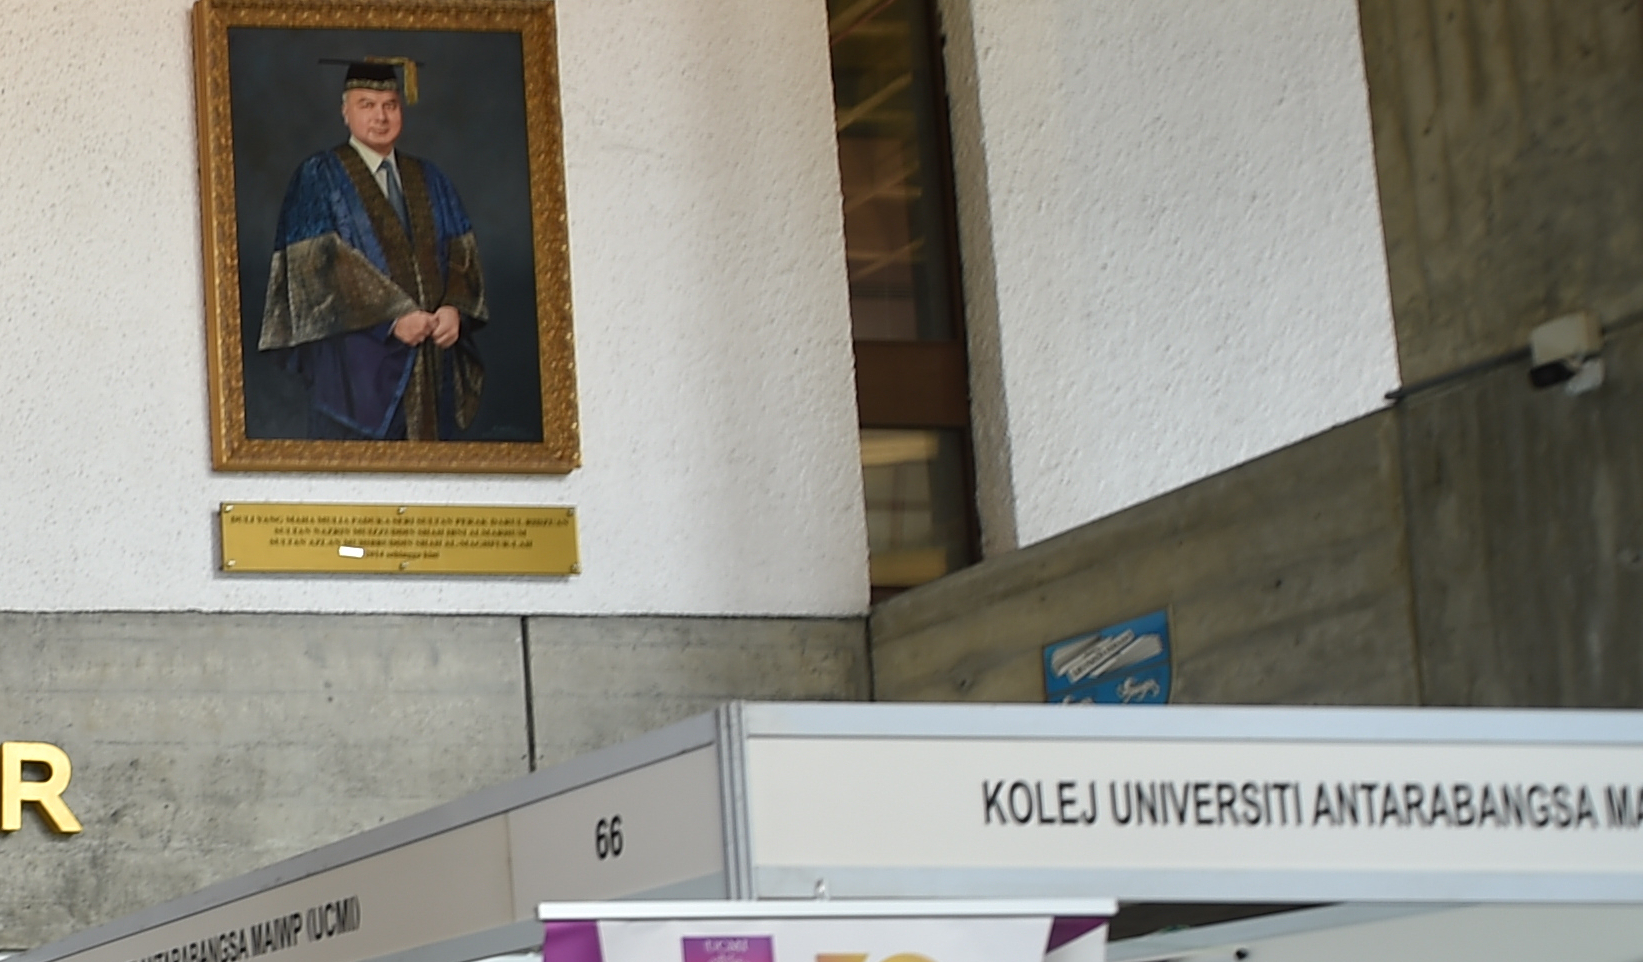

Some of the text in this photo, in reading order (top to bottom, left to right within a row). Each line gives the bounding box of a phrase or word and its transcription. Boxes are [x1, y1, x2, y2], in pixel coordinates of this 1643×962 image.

[982, 780, 1098, 826] KOLEJ
[1110, 782, 1303, 827] UNIVERSITI
[1312, 783, 1599, 829] ANTARABANGSA
[594, 815, 624, 861] 66
